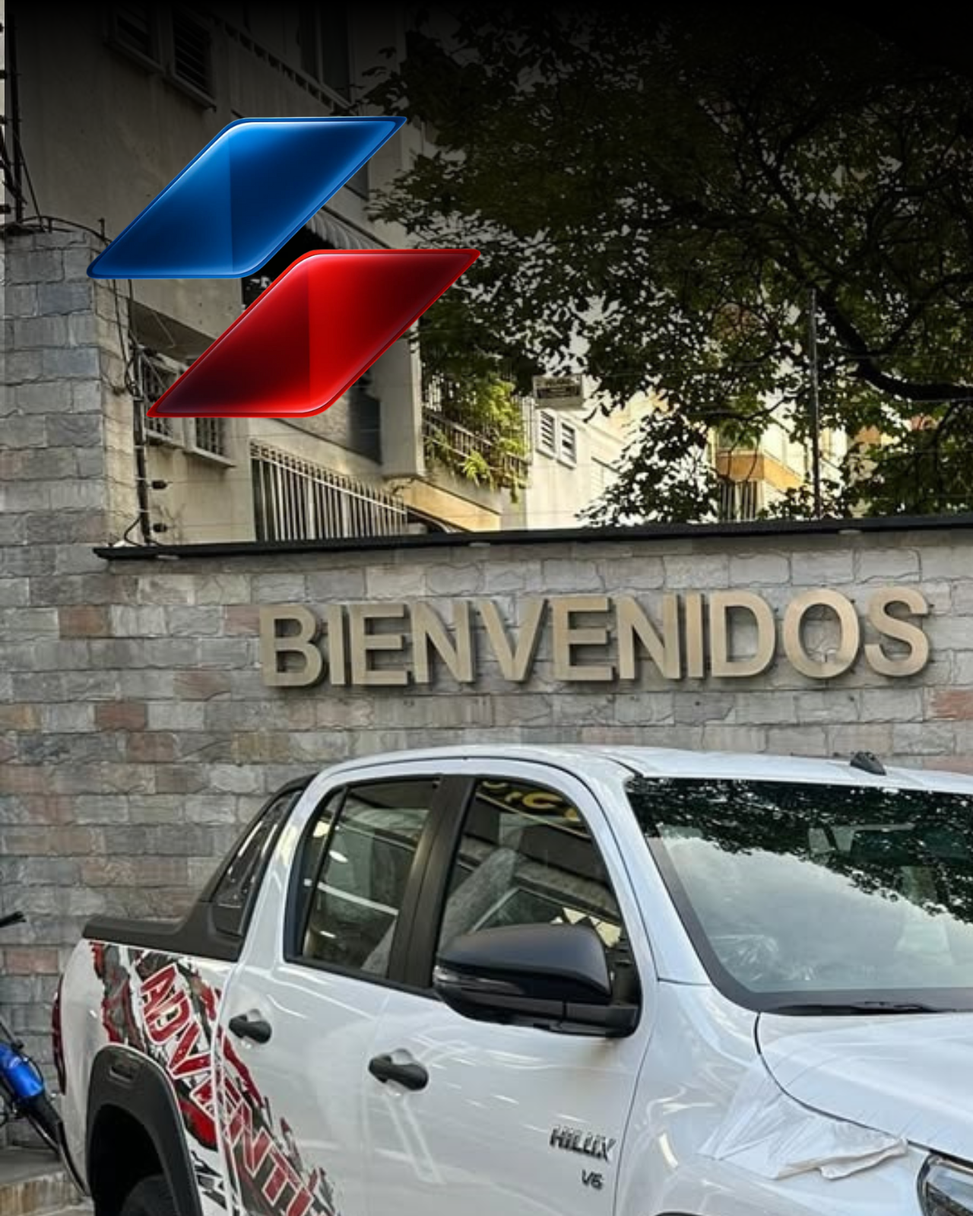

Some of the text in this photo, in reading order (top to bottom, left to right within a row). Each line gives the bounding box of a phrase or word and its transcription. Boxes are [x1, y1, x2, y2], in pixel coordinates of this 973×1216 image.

[259, 586, 930, 688] BIENVENIDOS
[549, 1126, 617, 1163] HILUX
[581, 1168, 604, 1191] V6
